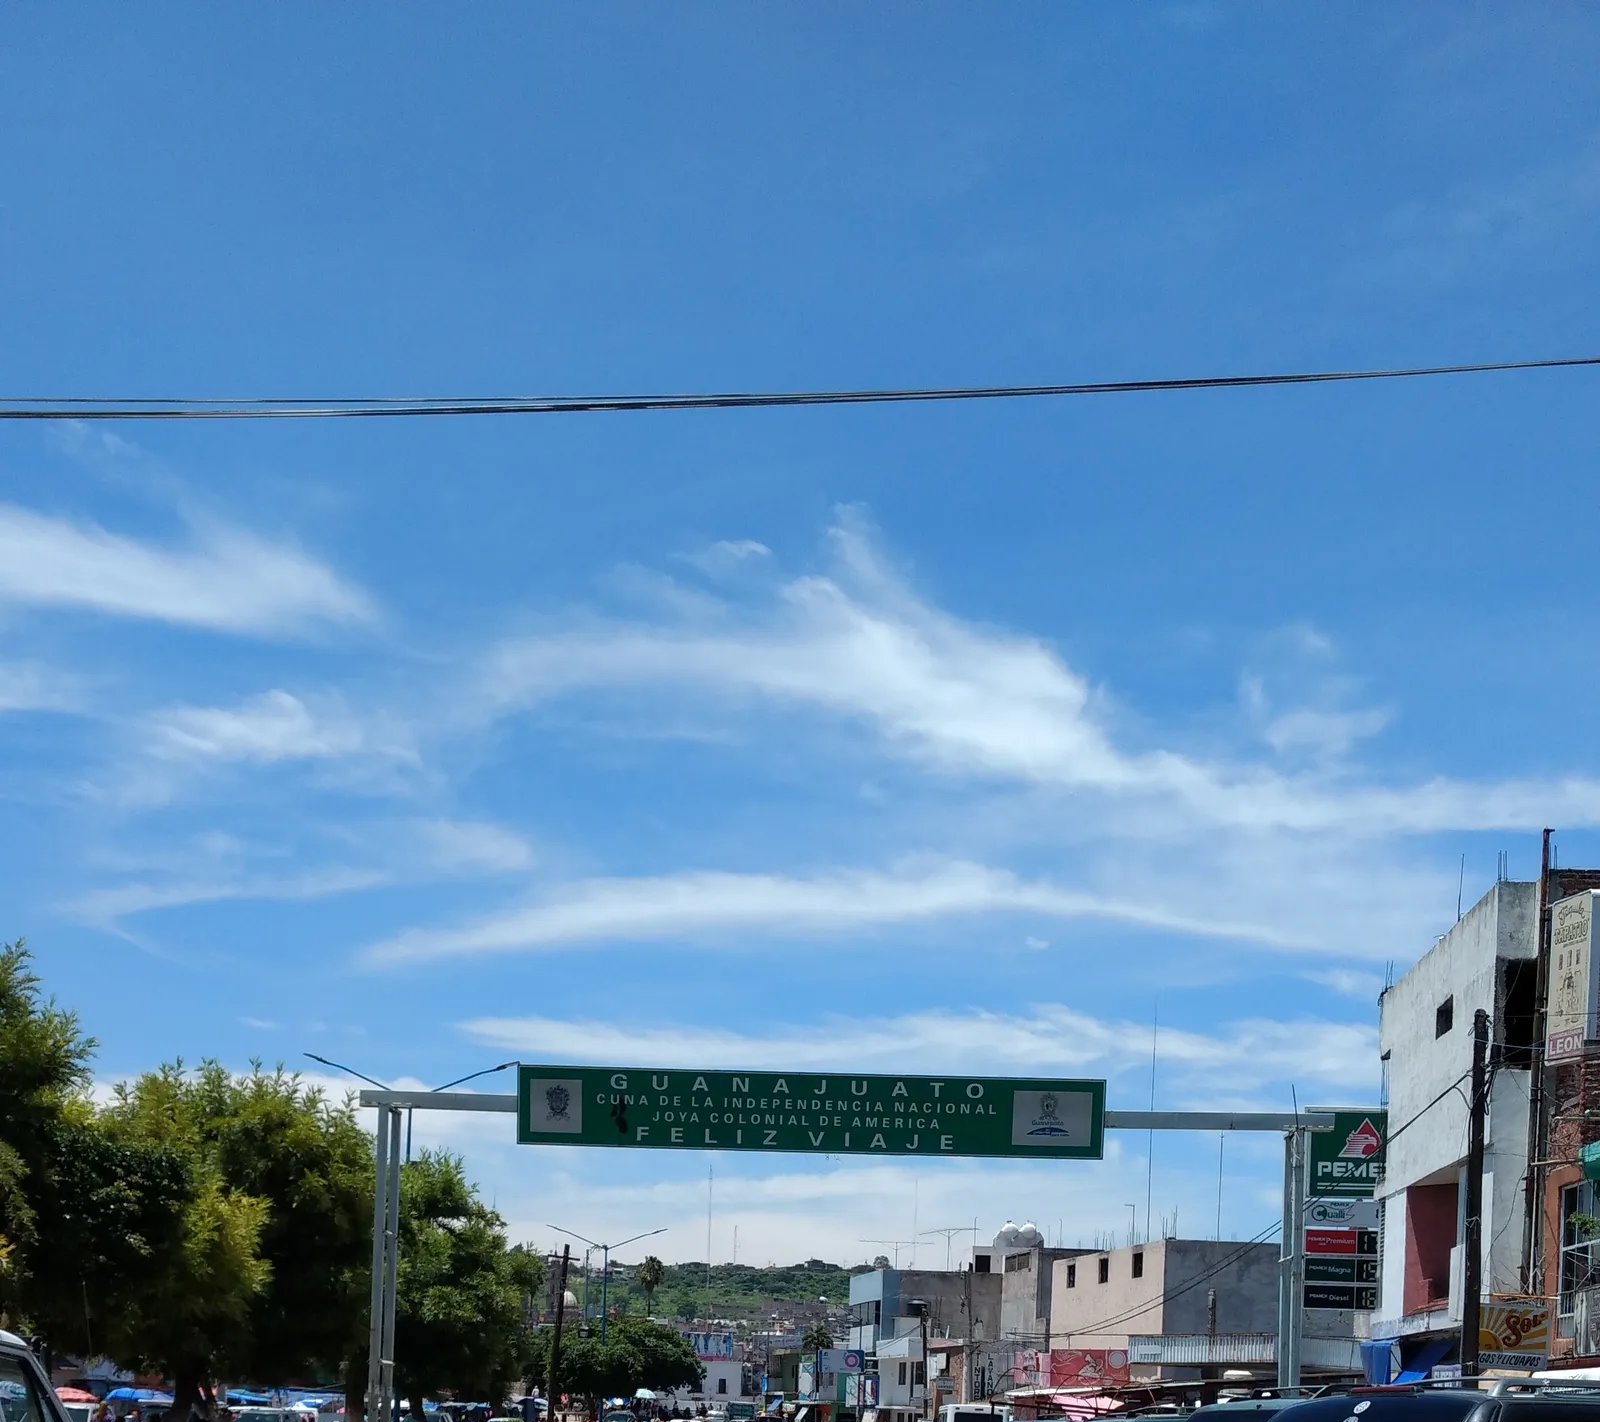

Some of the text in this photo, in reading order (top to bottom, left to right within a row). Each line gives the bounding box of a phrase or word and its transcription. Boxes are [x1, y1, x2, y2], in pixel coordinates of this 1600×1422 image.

[1549, 1033, 1583, 1056] LEON
[610, 1073, 985, 1099] GUANAJUATO
[596, 1093, 997, 1115] CUNA DE LA INDEPENDENCIA NACIONAL
[652, 1111, 940, 1130] JOYA COLONIAL DE AMERICA
[636, 1126, 954, 1150] FELIZ VIAJE
[1317, 1161, 1386, 1178] PEME
[1326, 1236, 1355, 1245] Premium
[1328, 1265, 1352, 1275] Magna
[1329, 1293, 1350, 1303] Diesel
